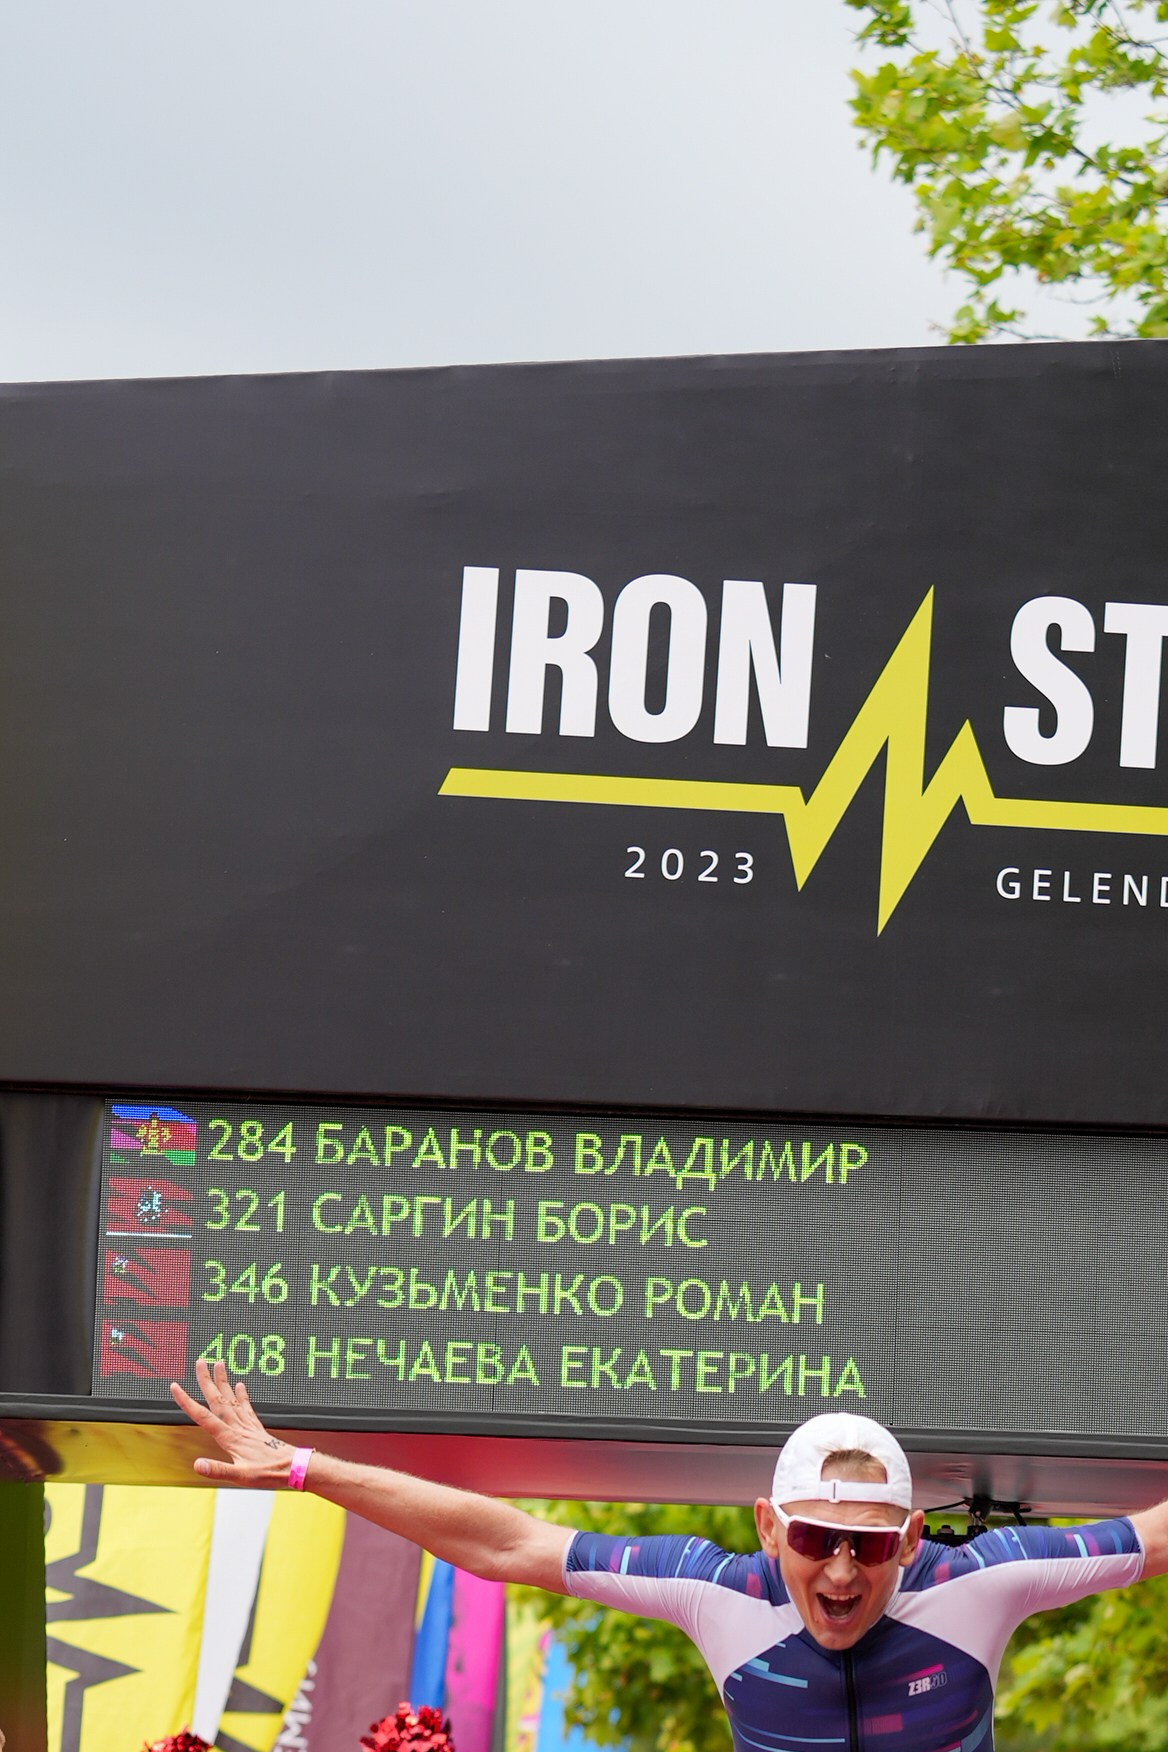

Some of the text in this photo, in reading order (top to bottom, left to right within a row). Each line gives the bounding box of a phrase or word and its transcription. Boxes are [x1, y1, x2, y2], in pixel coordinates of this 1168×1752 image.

[452, 566, 817, 749] IRON
[624, 845, 757, 886] 2023
[206, 1119, 298, 1163] 284
[315, 1122, 554, 1174] БАРАНОВ
[574, 1132, 869, 1190] ВЛАДИМИР
[205, 1189, 288, 1234] 321
[311, 1193, 515, 1242] САРГИН
[537, 1203, 709, 1248] БОРИС
[202, 1260, 289, 1304] 346
[310, 1263, 623, 1318] КУЗЬМЕНКО
[645, 1276, 823, 1325] РОМАН
[199, 1333, 286, 1376] 408
[307, 1336, 540, 1388] НЕЧАЕВА
[560, 1345, 868, 1399] ЕКАТЕРИНА
